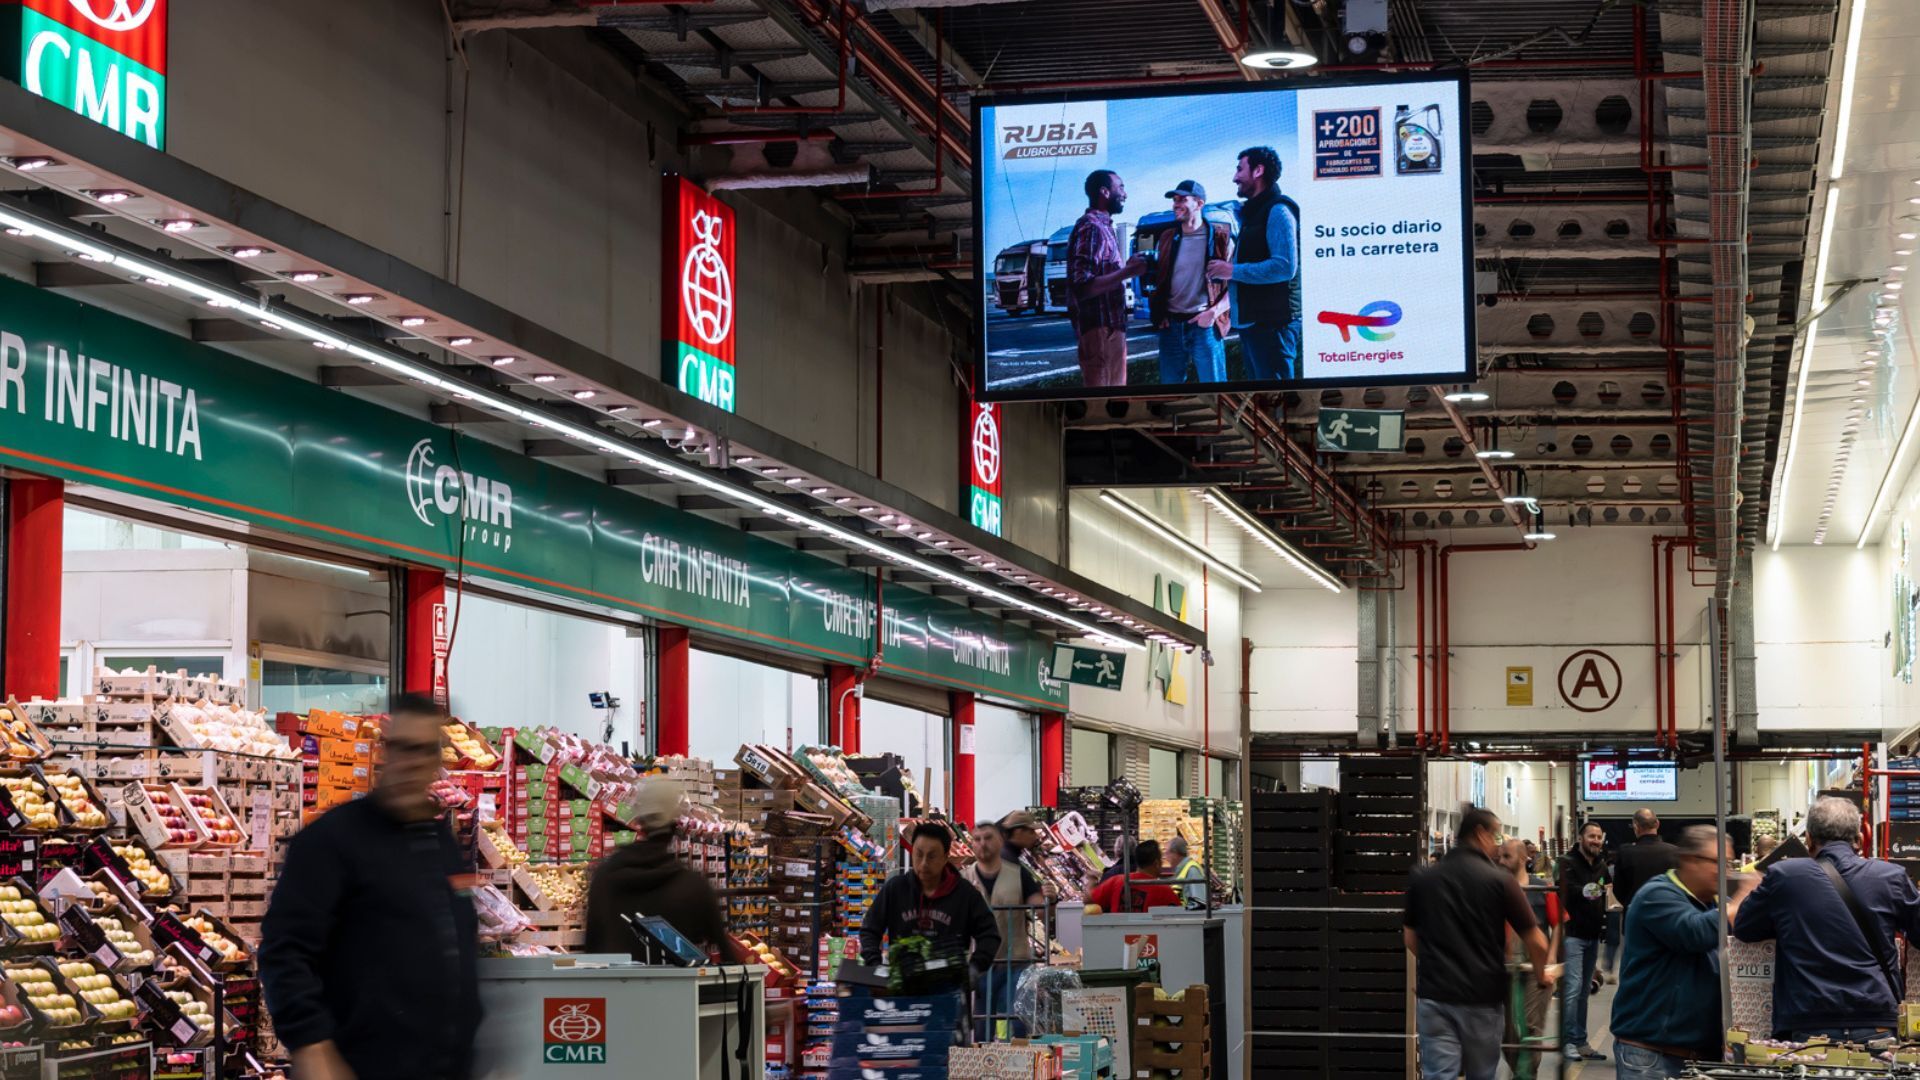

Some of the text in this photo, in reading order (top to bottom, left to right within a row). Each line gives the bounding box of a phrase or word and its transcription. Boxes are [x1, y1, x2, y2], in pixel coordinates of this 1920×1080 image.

[26, 31, 159, 149] CMR
[1320, 114, 1375, 138] +200
[1016, 145, 1093, 157] LUBRICANTES
[1318, 137, 1377, 148] APROBACIONES
[1314, 219, 1442, 238] Su socio diario
[1315, 242, 1440, 258] en la carretera
[1318, 350, 1404, 363] TotalEnergies
[679, 353, 734, 414] CMR
[44, 344, 202, 461] INFINITA
[434, 464, 512, 530] CMR
[971, 492, 1001, 538] CMR
[641, 532, 750, 609] CMR INFINITA
[823, 588, 853, 637] CMR
[1571, 658, 1609, 699] A
[1763, 964, 1771, 976] B
[546, 1044, 604, 1061] CMR
